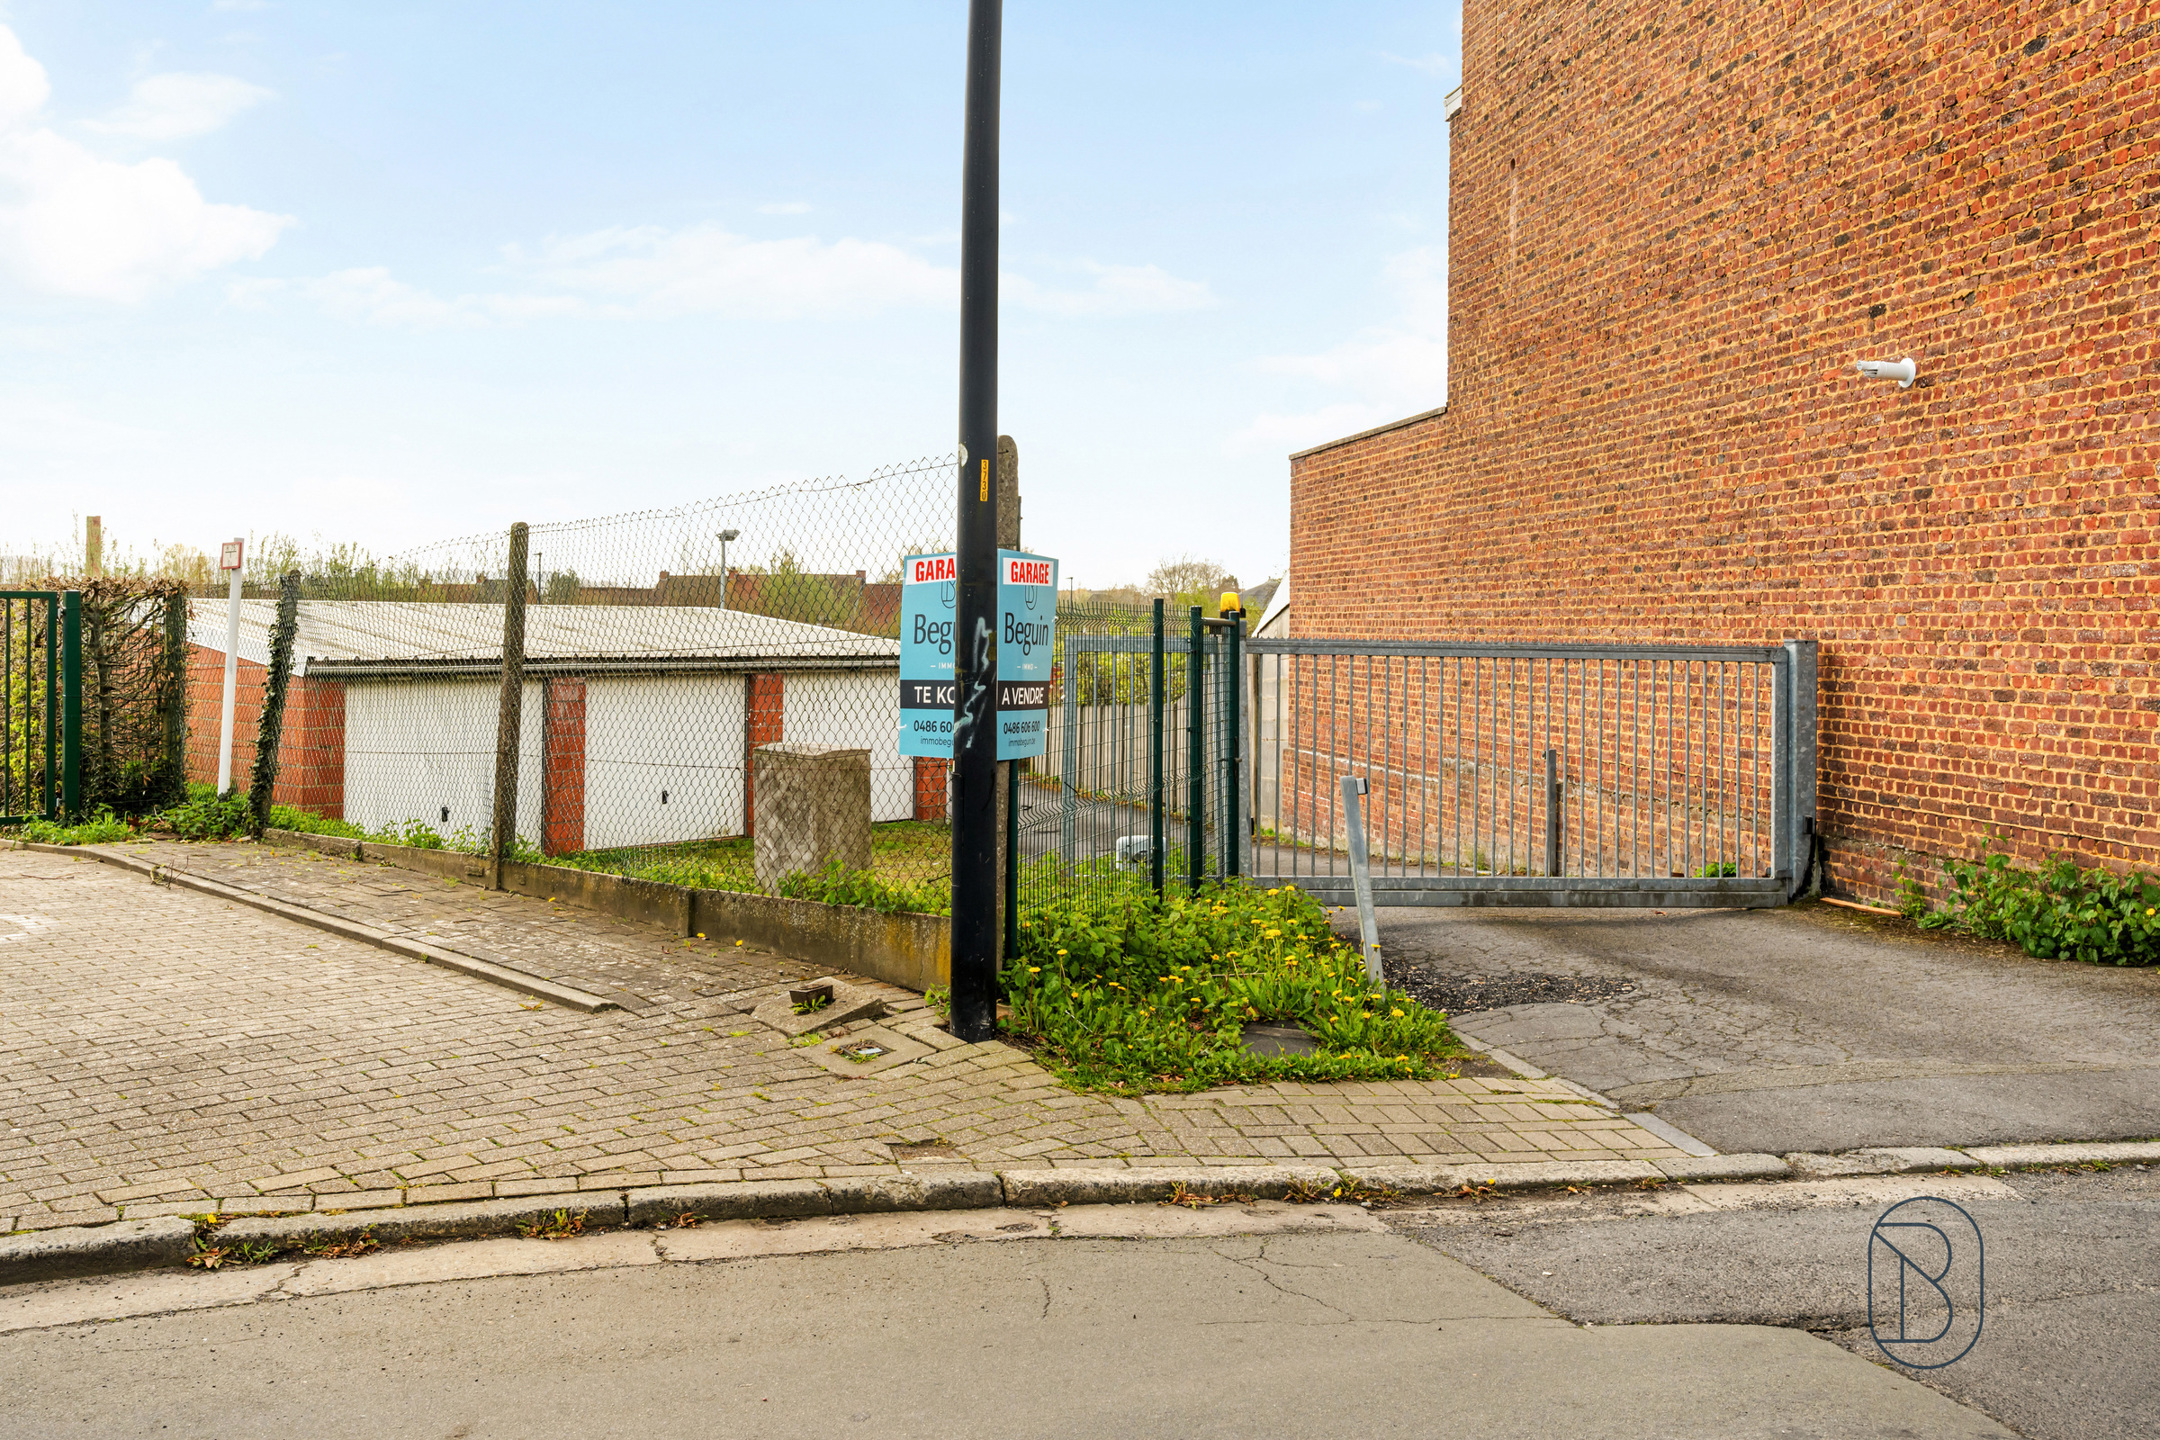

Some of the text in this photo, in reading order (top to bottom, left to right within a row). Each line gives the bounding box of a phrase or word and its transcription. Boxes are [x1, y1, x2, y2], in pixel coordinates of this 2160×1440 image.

[1011, 561, 1050, 585] GARAGE
[1004, 612, 1049, 656] Beguin
[914, 686, 932, 704] TE
[1001, 686, 1045, 705] A VENDRE
[913, 719, 955, 733] 0486 60
[1003, 722, 1020, 735] 0486
[1021, 721, 1031, 733] 606
[1008, 736, 1036, 748] immobeguin.be
